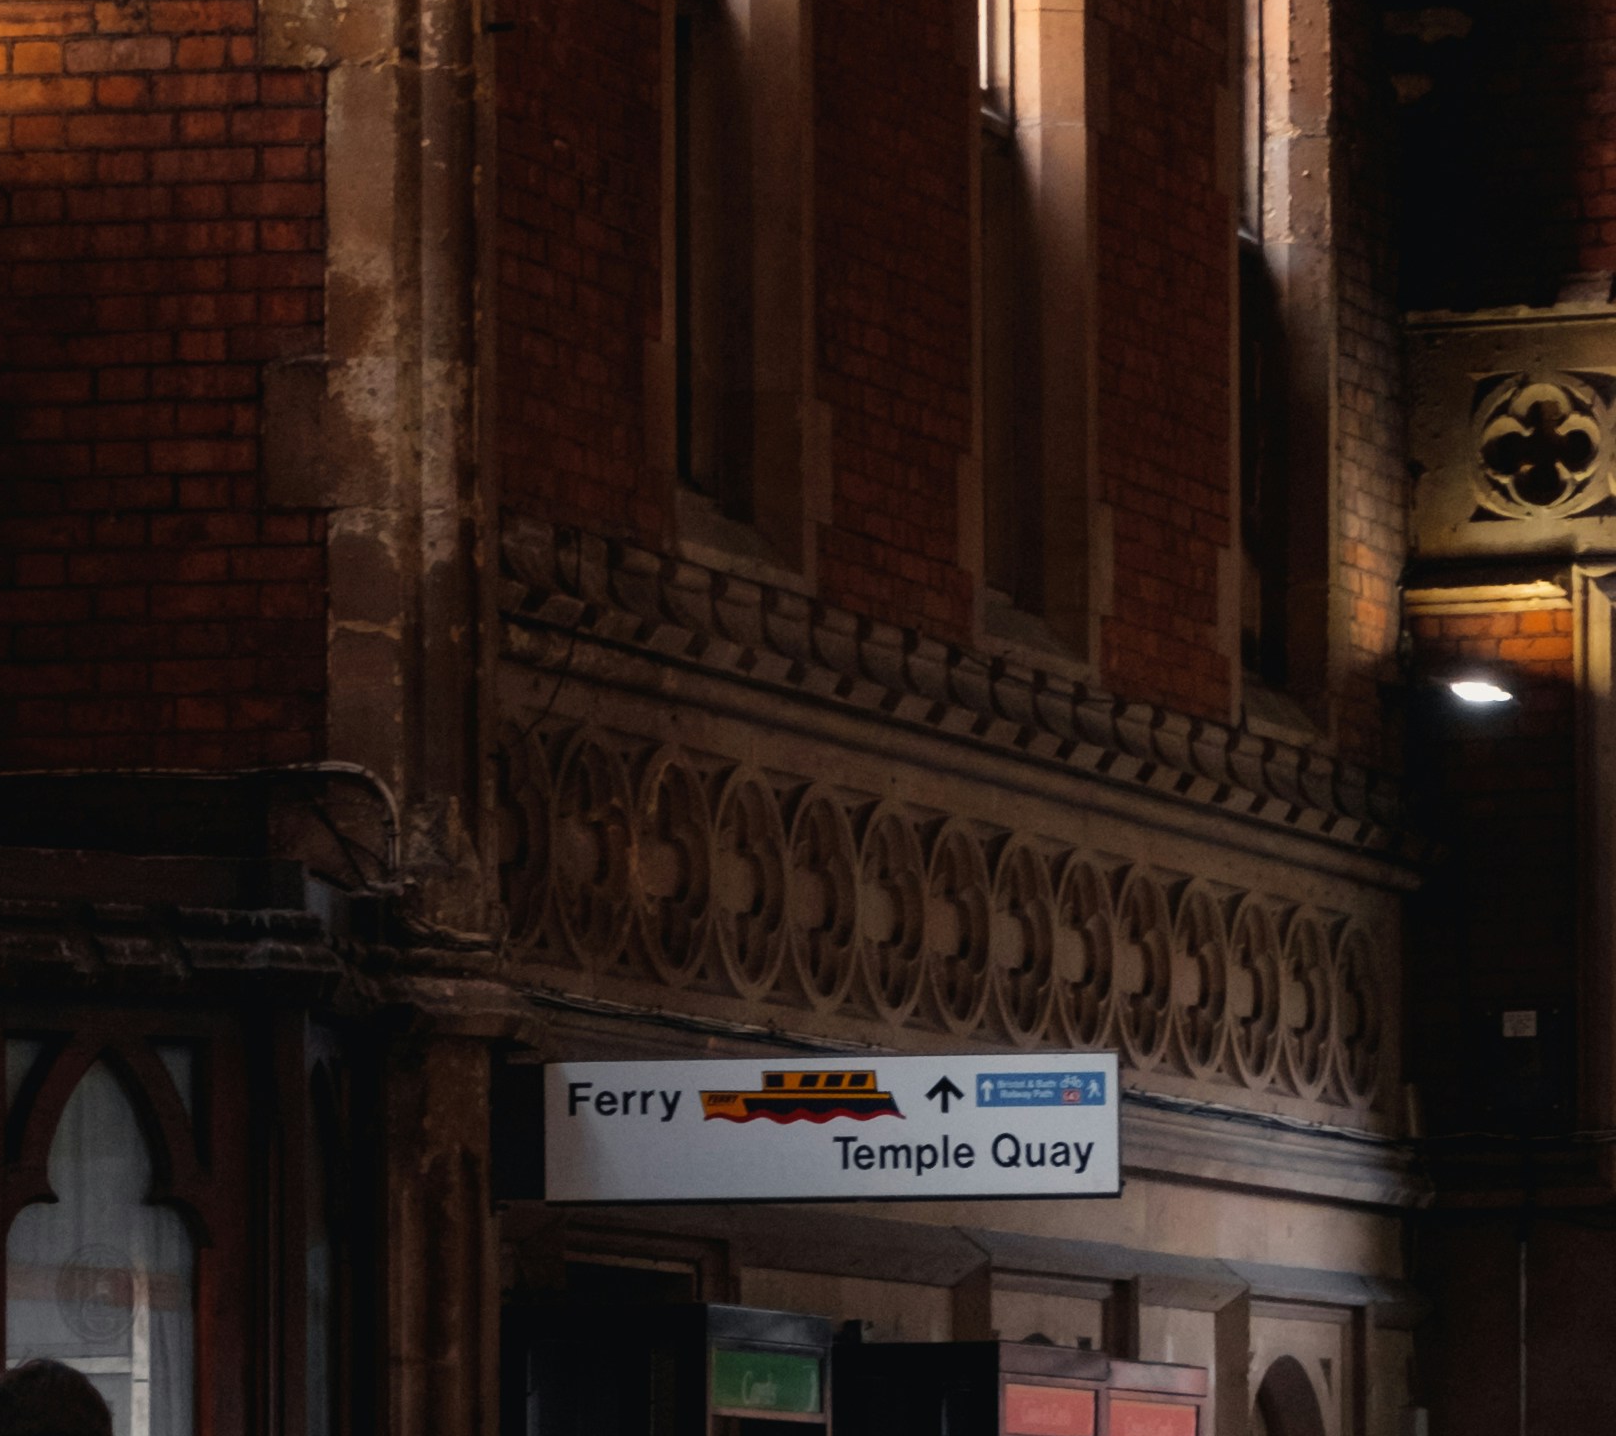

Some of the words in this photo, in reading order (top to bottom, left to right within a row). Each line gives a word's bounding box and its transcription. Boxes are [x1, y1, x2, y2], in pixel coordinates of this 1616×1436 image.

[568, 1082, 682, 1122] Ferry
[833, 1135, 975, 1175] Temple
[991, 1133, 1094, 1173] Quay
